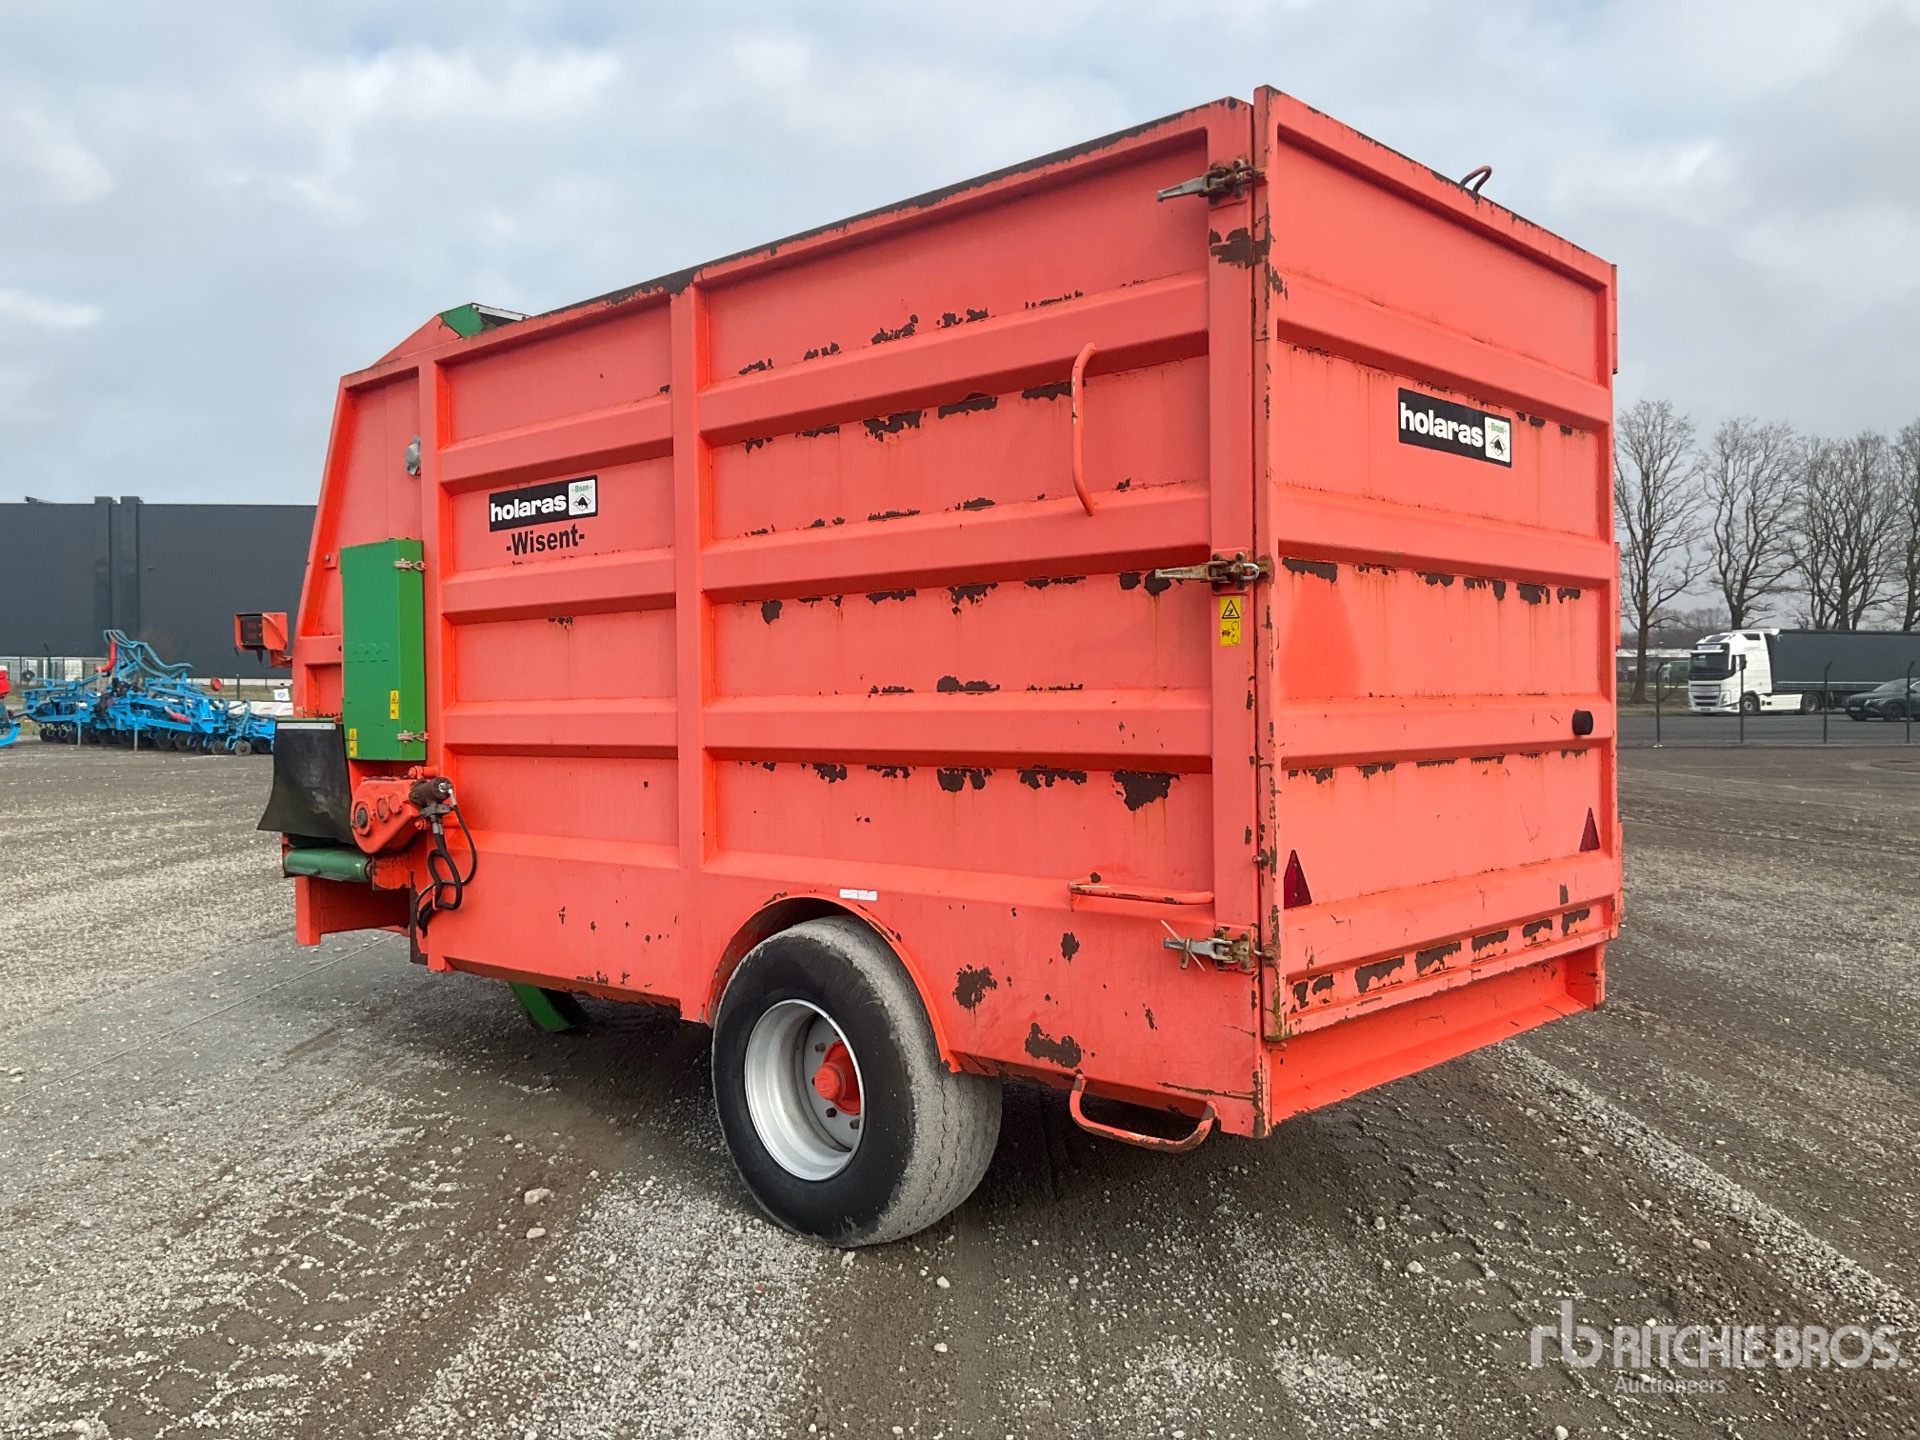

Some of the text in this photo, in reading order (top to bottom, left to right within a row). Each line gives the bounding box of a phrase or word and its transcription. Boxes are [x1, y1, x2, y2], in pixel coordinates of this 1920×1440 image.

[1400, 401, 1484, 448] holaras
[491, 494, 567, 522] holaras
[506, 523, 585, 556] -Wisent-
